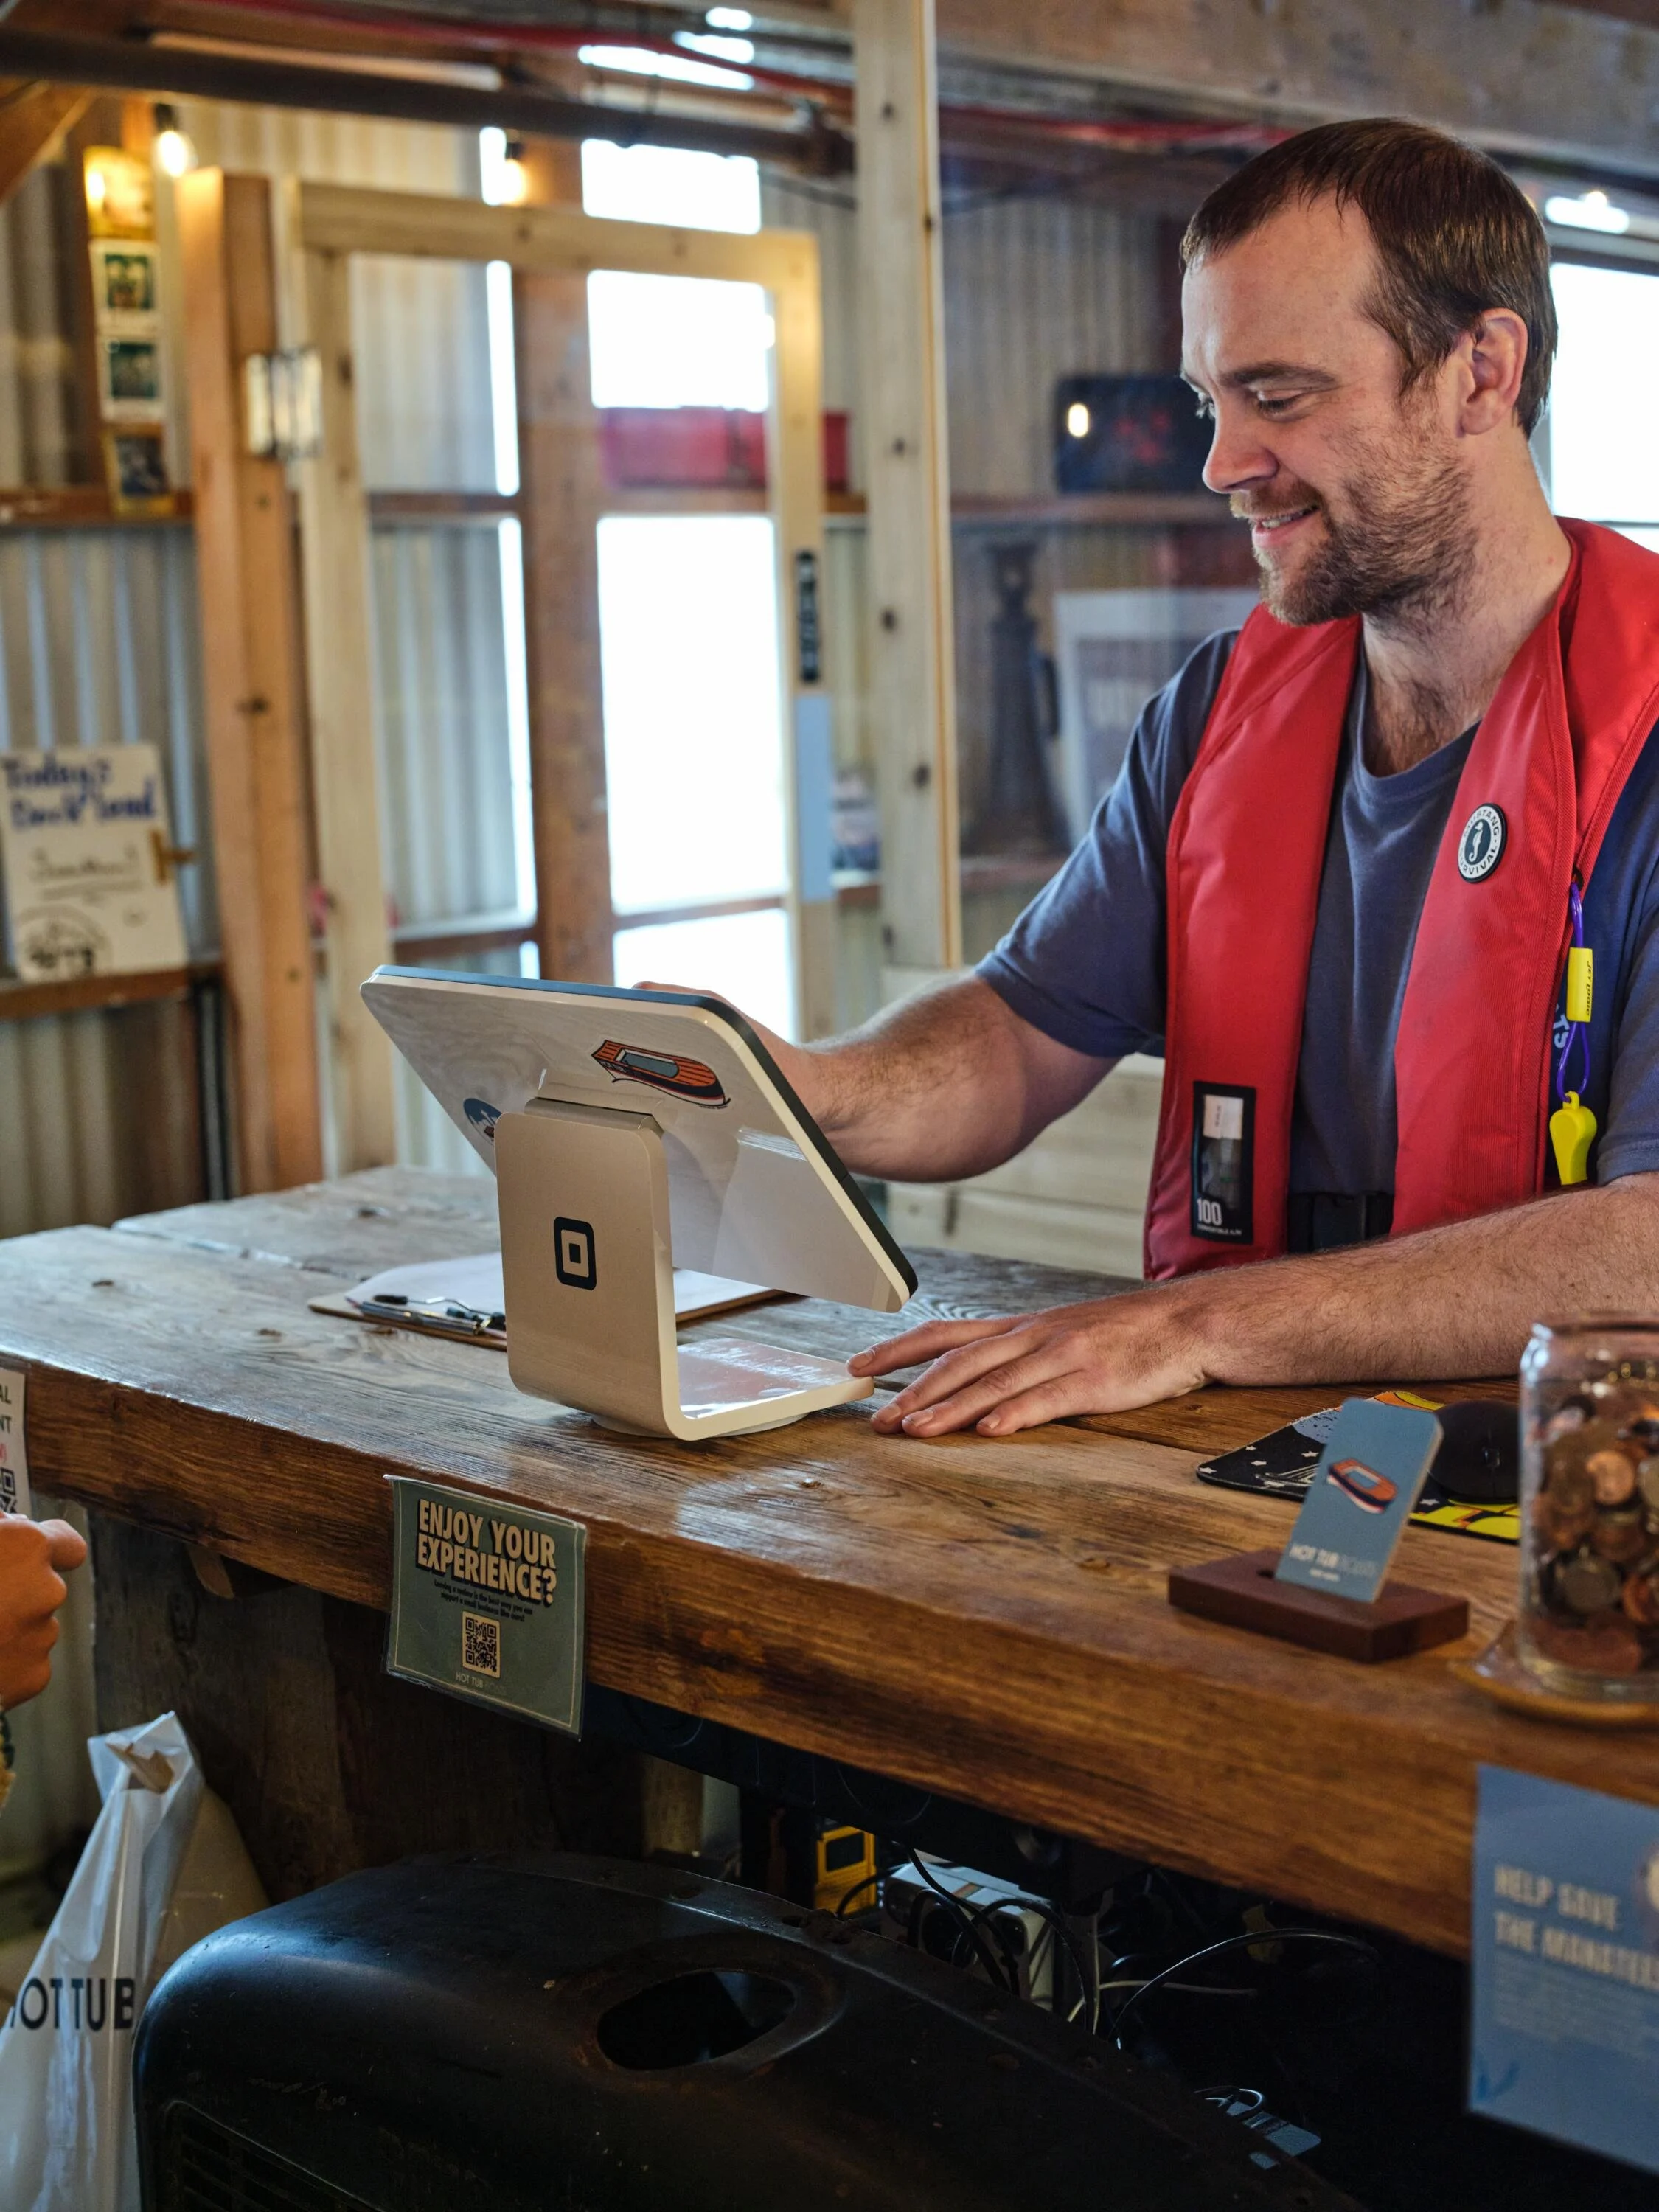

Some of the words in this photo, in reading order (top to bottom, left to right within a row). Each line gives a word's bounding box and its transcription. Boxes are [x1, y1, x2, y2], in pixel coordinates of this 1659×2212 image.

[1197, 1197, 1222, 1225] 100
[417, 1498, 484, 1549] ENJOY
[490, 1520, 557, 1570] YOUR
[416, 1531, 557, 1606] EXPERIENCE?
[456, 1672, 470, 1684] HOT
[472, 1676, 484, 1689] TUB
[1494, 1863, 1554, 1908] HELP
[1558, 1882, 1618, 1932] SAVE
[1494, 1910, 1536, 1952] THE
[71, 1978, 136, 2032] TUB
